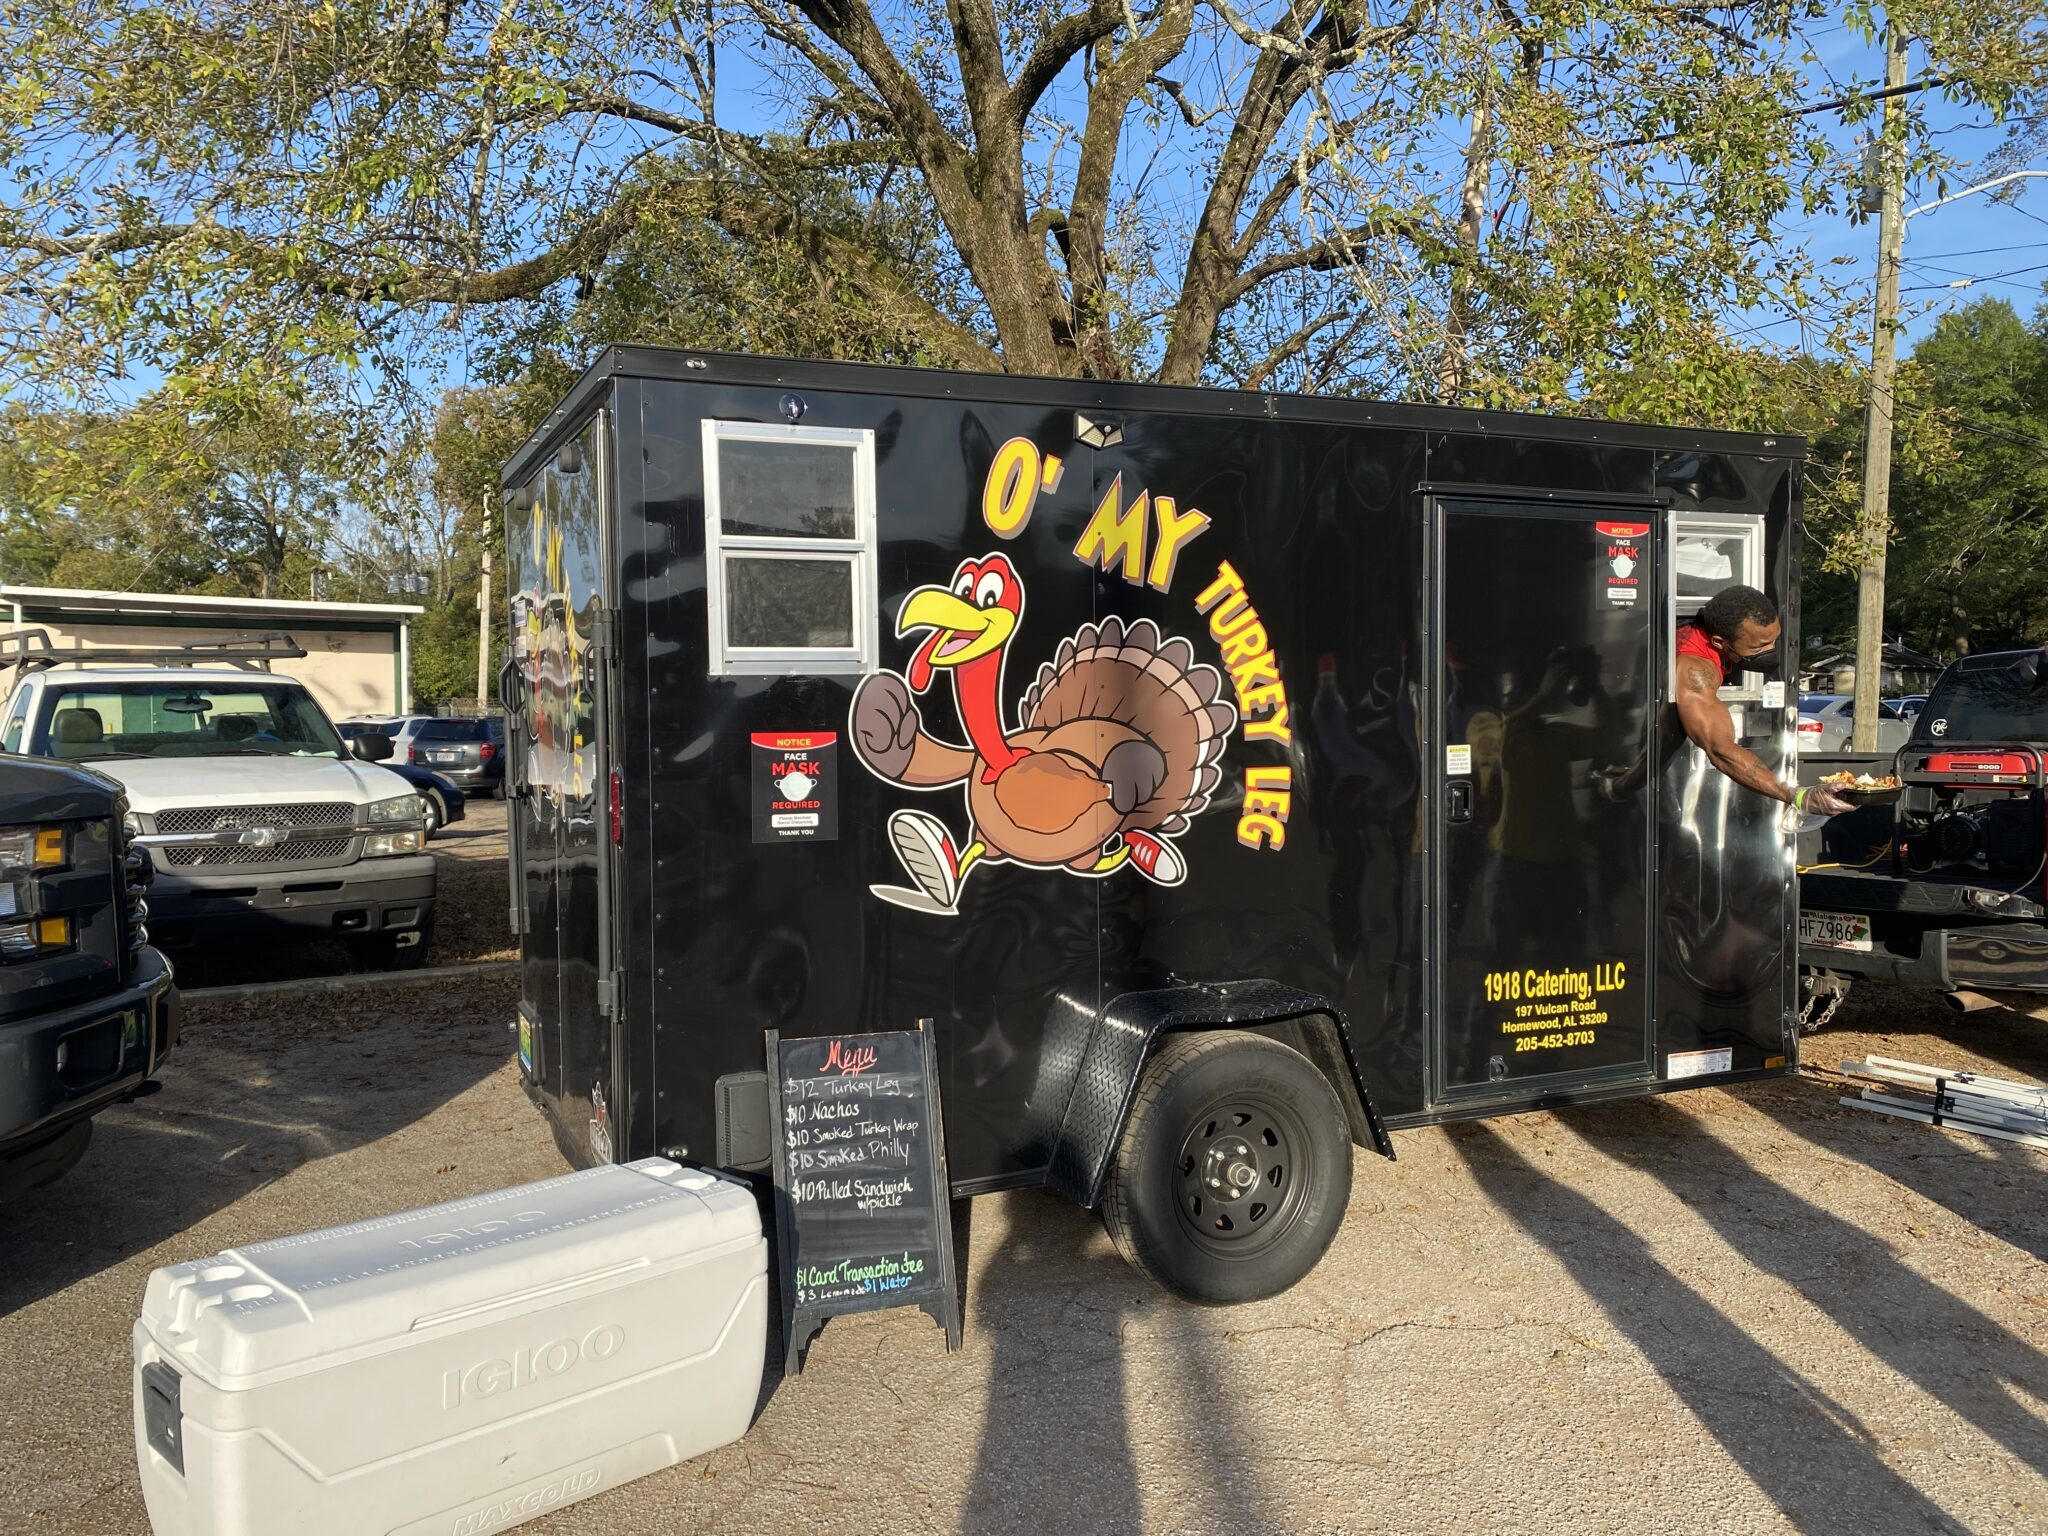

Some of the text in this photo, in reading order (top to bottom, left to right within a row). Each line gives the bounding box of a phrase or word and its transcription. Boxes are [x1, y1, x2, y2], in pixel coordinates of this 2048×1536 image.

[1073, 470, 1211, 594] MY
[1608, 546, 1638, 558] MASK
[1194, 560, 1292, 747] TURKEY
[777, 738, 811, 746] NOTICE
[772, 762, 820, 776] MASK
[784, 753, 807, 761] FACE
[772, 801, 820, 809] REQUIRED
[1237, 766, 1291, 853] LEG
[1484, 961, 1626, 1001] 1918 Catering, LLC
[1515, 998, 1597, 1018] 197 Vulcan Road
[1502, 1012, 1608, 1033] Homewood, AL 35209
[1515, 1030, 1595, 1052] 205-452-8703
[820, 1040, 877, 1074] Menu
[785, 1075, 901, 1099] $12 Turkey Leg
[786, 1101, 860, 1126] $10 Nachos
[786, 1129, 809, 1149] $10
[855, 1121, 891, 1139] Turkey
[893, 1118, 918, 1137] Wrap
[788, 1150, 813, 1176] $10
[868, 1137, 909, 1166] Philly
[791, 1176, 913, 1205] $10 Pulled Sandwich
[857, 1195, 903, 1217] w/pickle
[796, 1266, 807, 1290] $1
[808, 1264, 839, 1287] Card
[838, 1256, 899, 1282] Transaction
[864, 1276, 912, 1293] $1 Water
[443, 1323, 626, 1410] IGLOO
